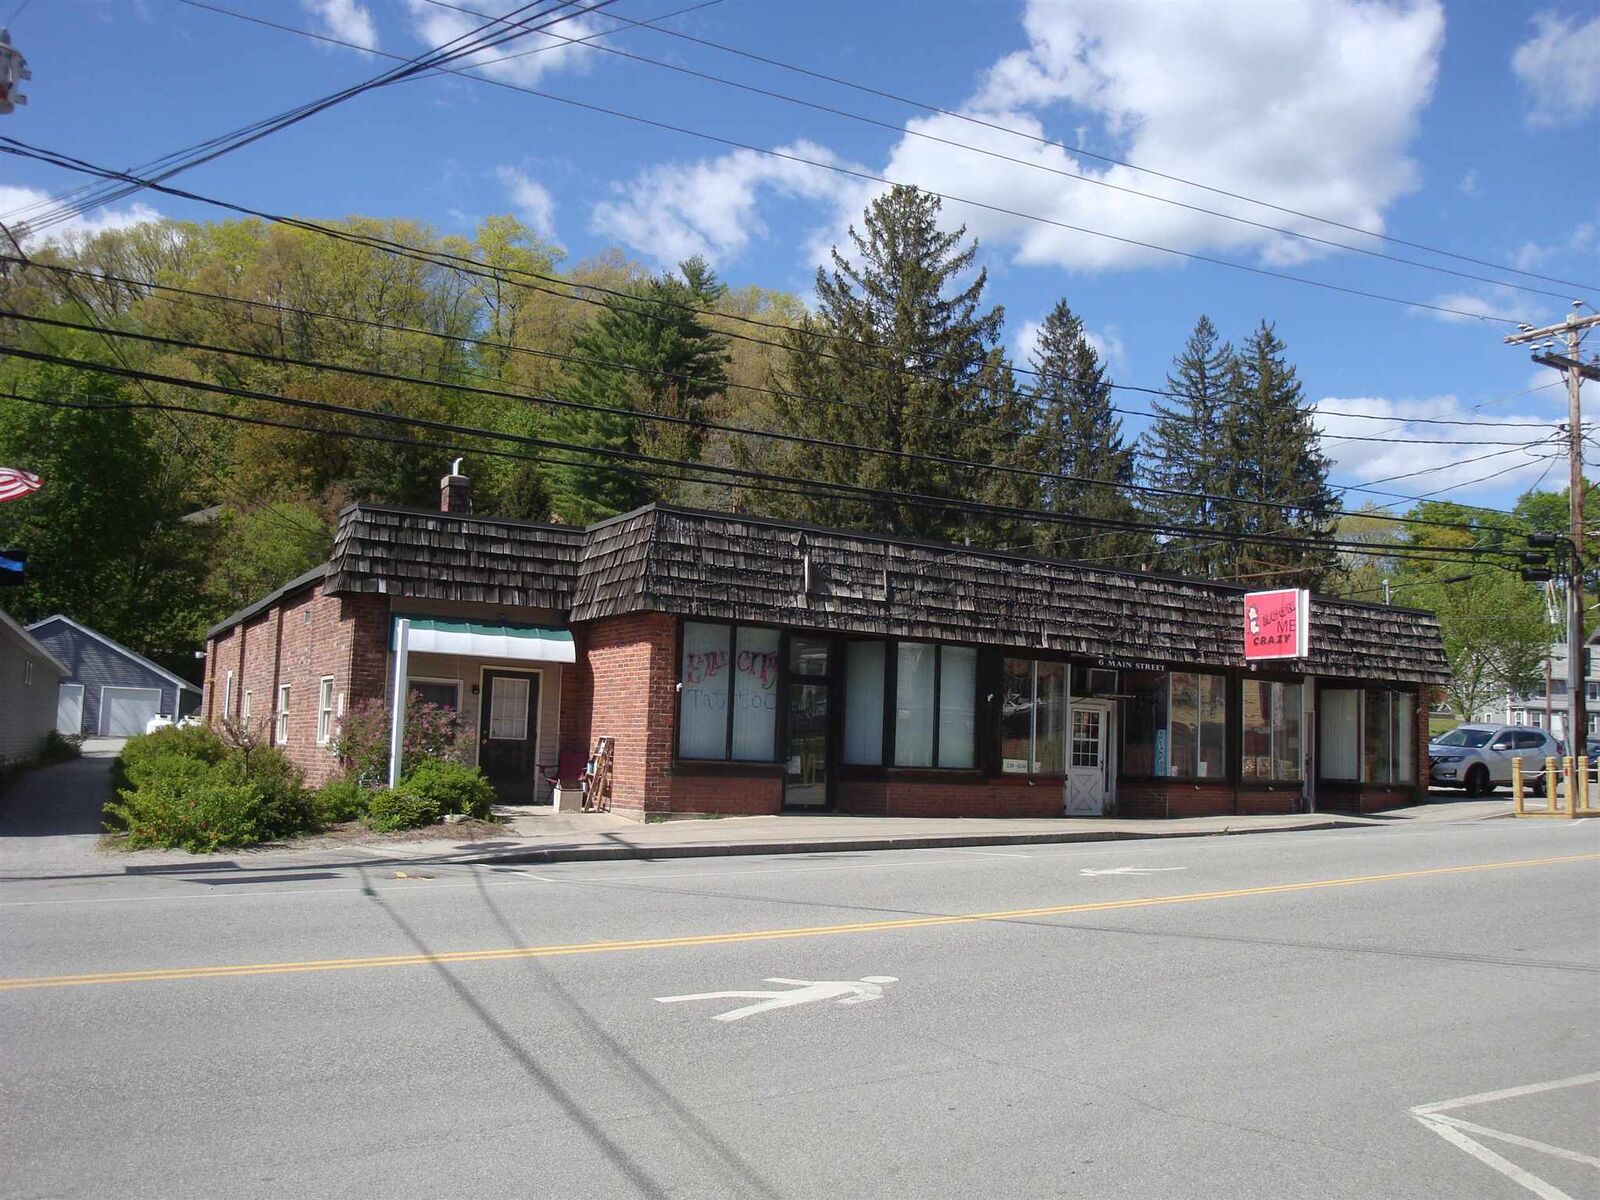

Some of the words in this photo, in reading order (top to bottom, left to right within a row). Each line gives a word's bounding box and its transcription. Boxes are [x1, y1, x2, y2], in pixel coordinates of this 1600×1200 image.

[1276, 620, 1296, 633] ME
[1253, 634, 1291, 647] CRAZY
[1107, 660, 1132, 668] MAIN
[1135, 662, 1166, 672] STREET
